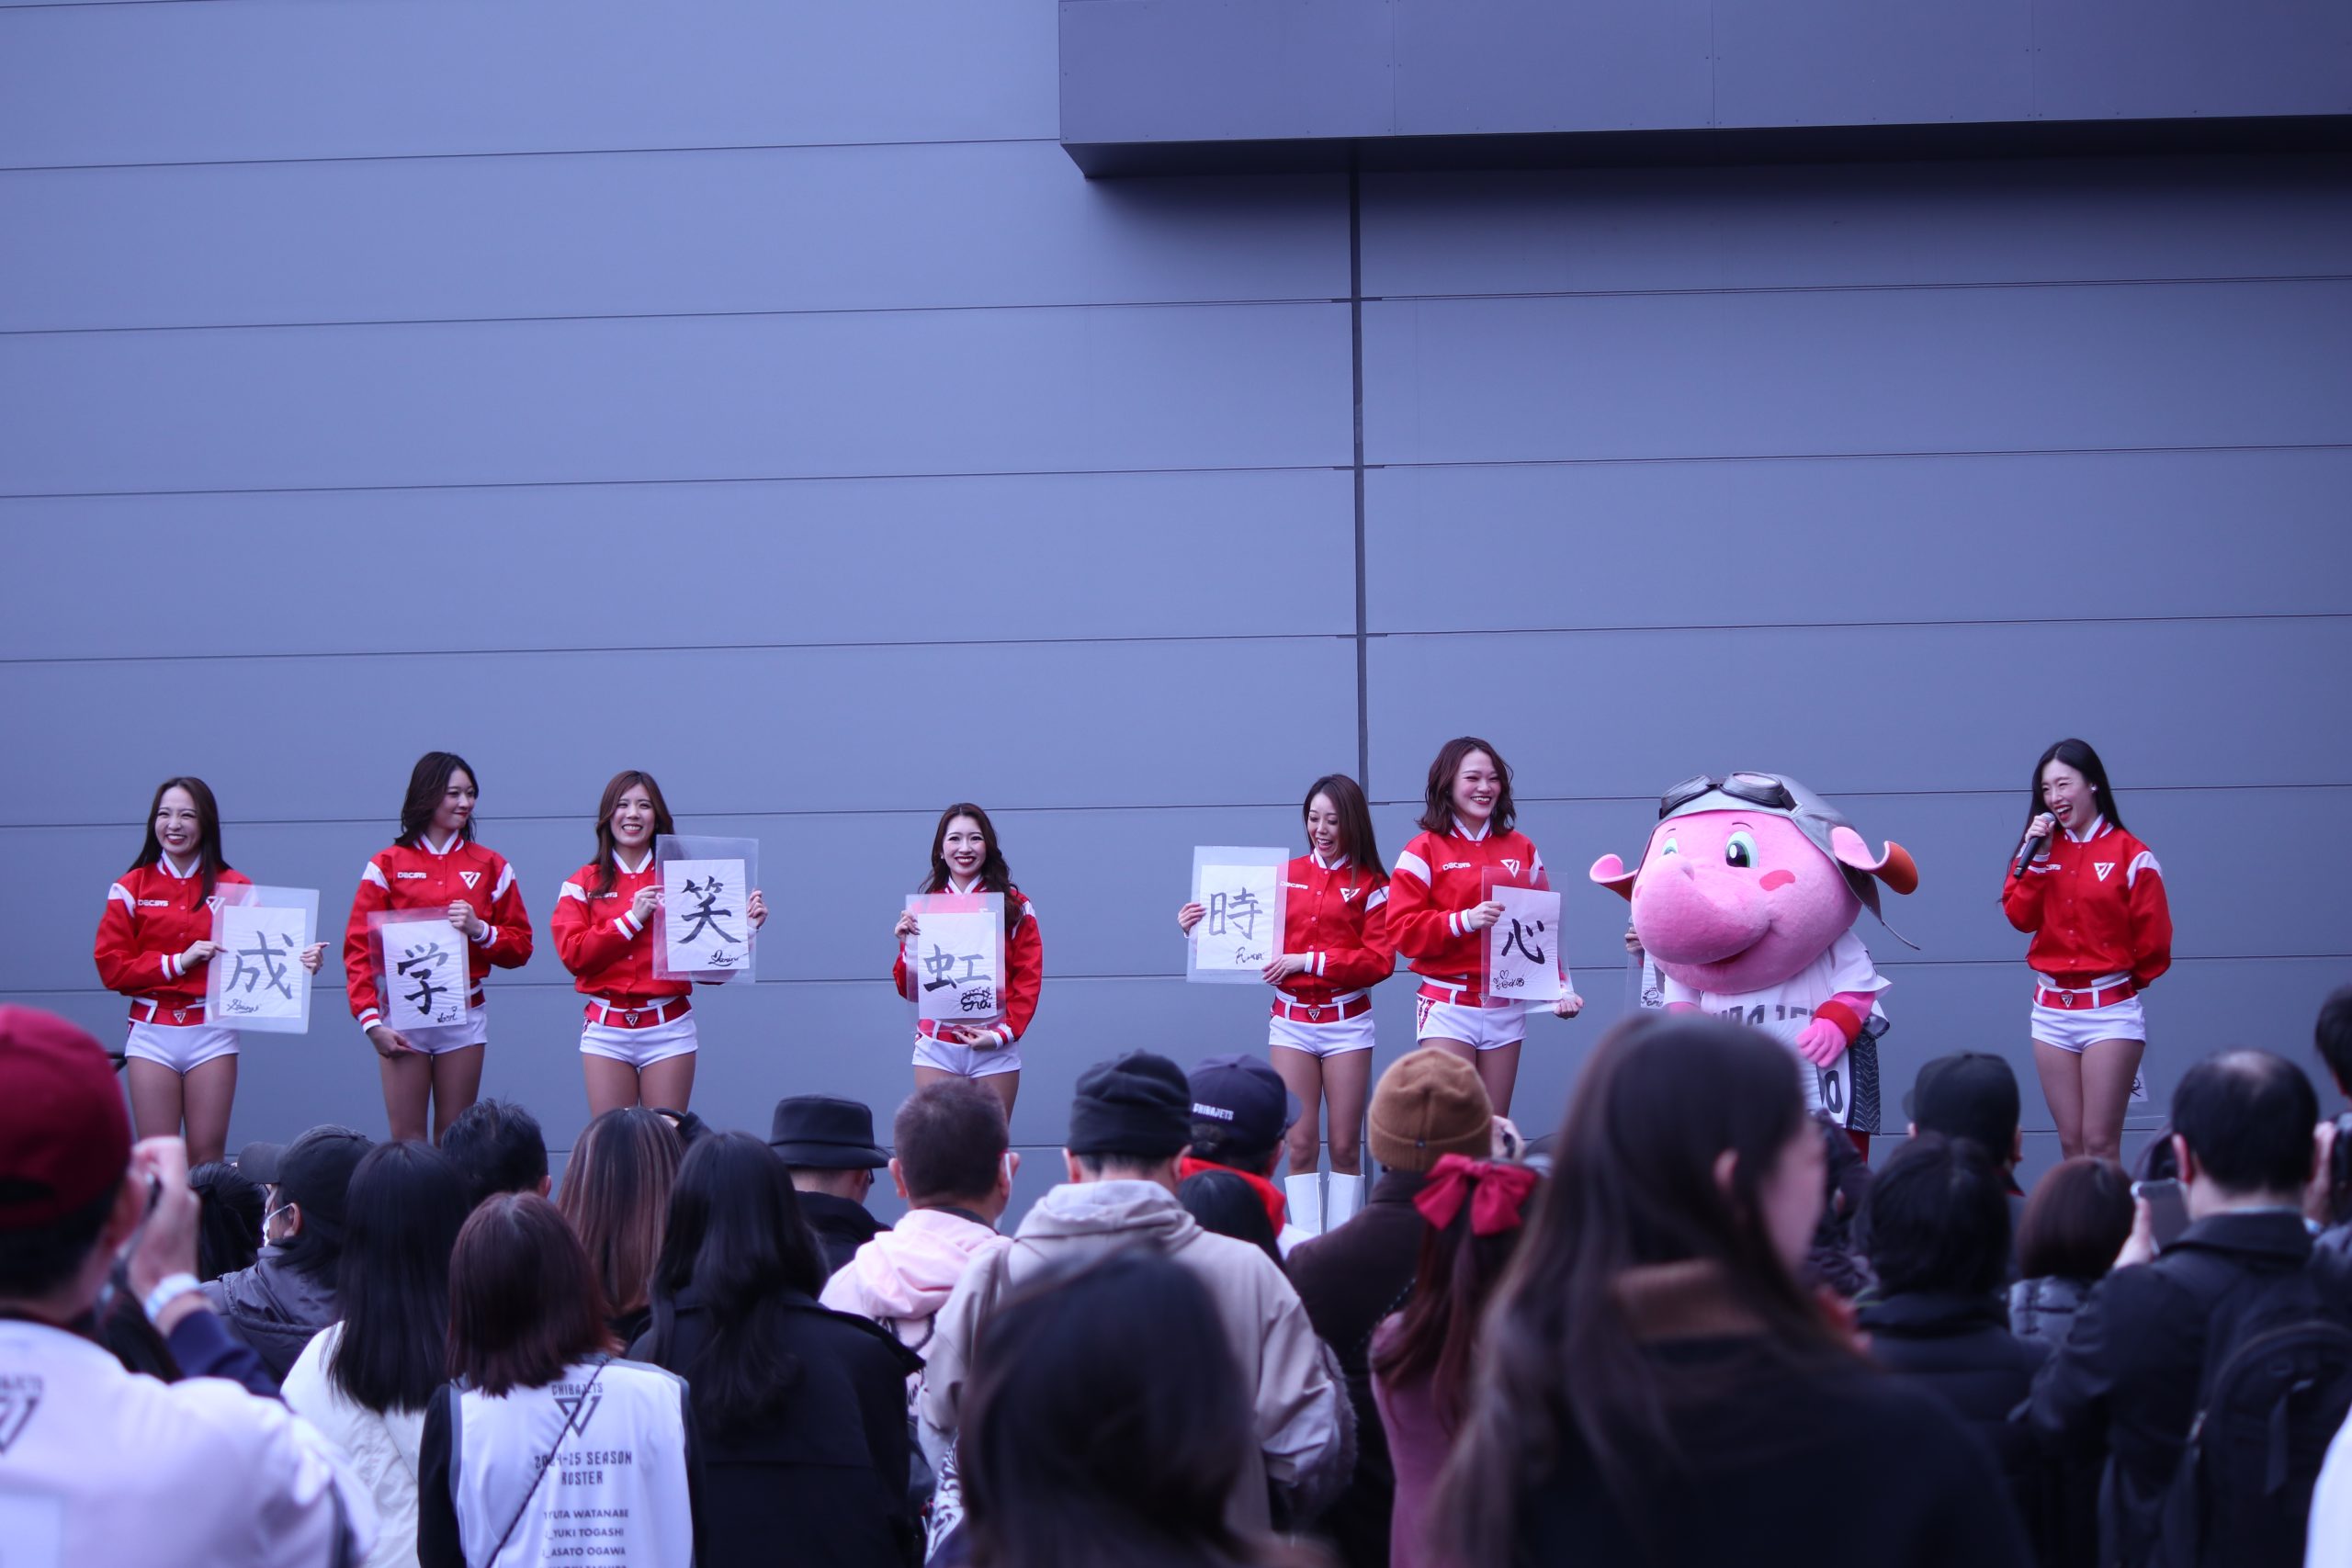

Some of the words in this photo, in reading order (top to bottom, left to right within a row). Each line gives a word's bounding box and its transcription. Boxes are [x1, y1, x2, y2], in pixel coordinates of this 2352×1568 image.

[677, 875, 741, 943] 笑
[1209, 886, 1263, 941] 時
[1501, 919, 1545, 964] 心
[225, 931, 294, 1000] 成
[397, 942, 449, 1015] 学
[923, 943, 991, 992] 虹
[561, 1471, 604, 1485] ROSTER
[586, 1450, 632, 1465] SEASON
[573, 1509, 628, 1518] WATANABE
[579, 1528, 624, 1538] TOGASHI
[587, 1547, 626, 1556] OGAWA
